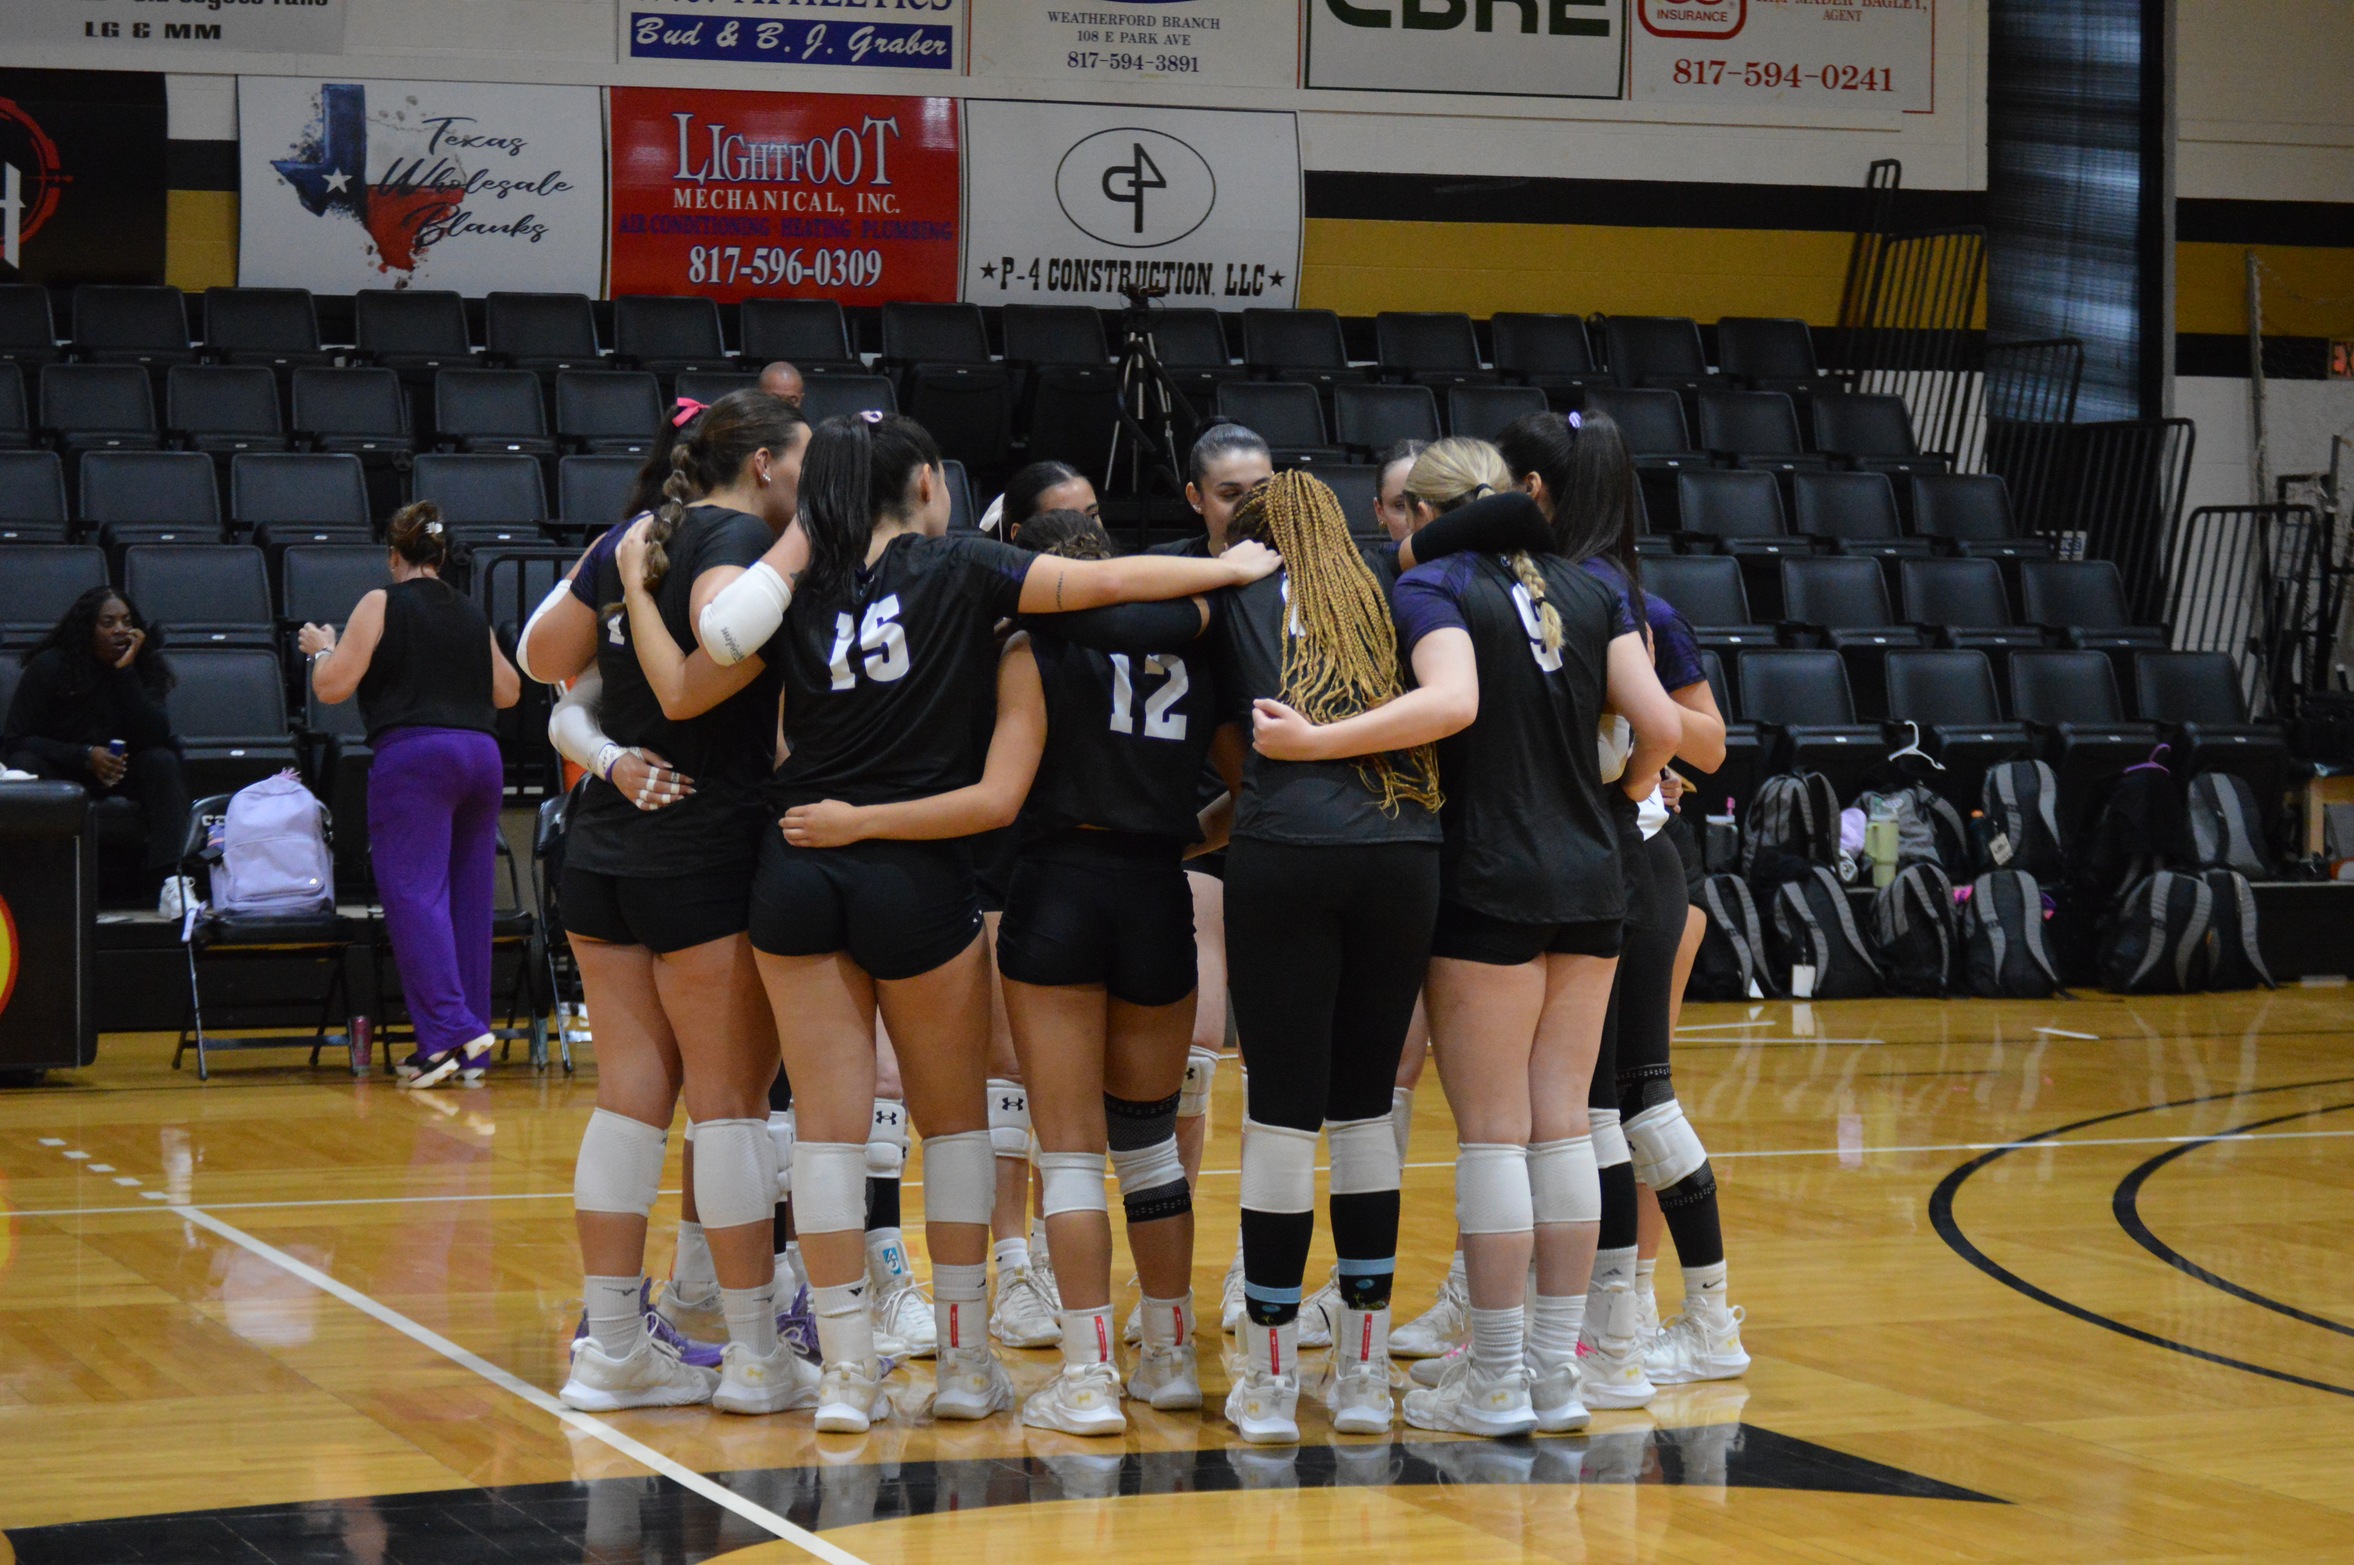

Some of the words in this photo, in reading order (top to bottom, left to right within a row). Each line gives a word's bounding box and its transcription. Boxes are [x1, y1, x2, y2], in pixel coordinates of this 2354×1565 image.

[84, 20, 121, 38] LG
[164, 23, 222, 40] MM
[1047, 11, 1157, 28] WEATHERFORD
[1162, 16, 1221, 30] BRANCH
[1656, 9, 1729, 23] INSURANCE
[1822, 8, 1864, 22] AGENT
[635, 16, 703, 47] Bud
[716, 20, 740, 48] &
[756, 21, 791, 53] B.
[801, 23, 834, 60] J.
[847, 25, 948, 62] Graber
[1077, 30, 1100, 42] 108
[1104, 31, 1115, 43] E
[1119, 31, 1159, 45] PARK
[1163, 33, 1192, 46] AVE
[1066, 50, 1200, 73] 817-594-3891
[1672, 58, 1895, 92] 817-594-0241
[422, 116, 528, 156] Texas
[378, 157, 575, 199] Wholesale
[673, 187, 845, 217] MECHANICAL,
[856, 193, 901, 214] INC.
[402, 201, 550, 249] Blanks
[618, 213, 648, 235] AIR
[650, 214, 771, 238] CONDITIONING
[780, 218, 852, 239] HEATING
[861, 220, 954, 242] PLUMBING
[688, 244, 883, 287] 817-596-0309
[999, 256, 1041, 291] P-4
[1224, 263, 1266, 297] LLC
[828, 593, 911, 691] 15
[1109, 653, 1190, 741] 12
